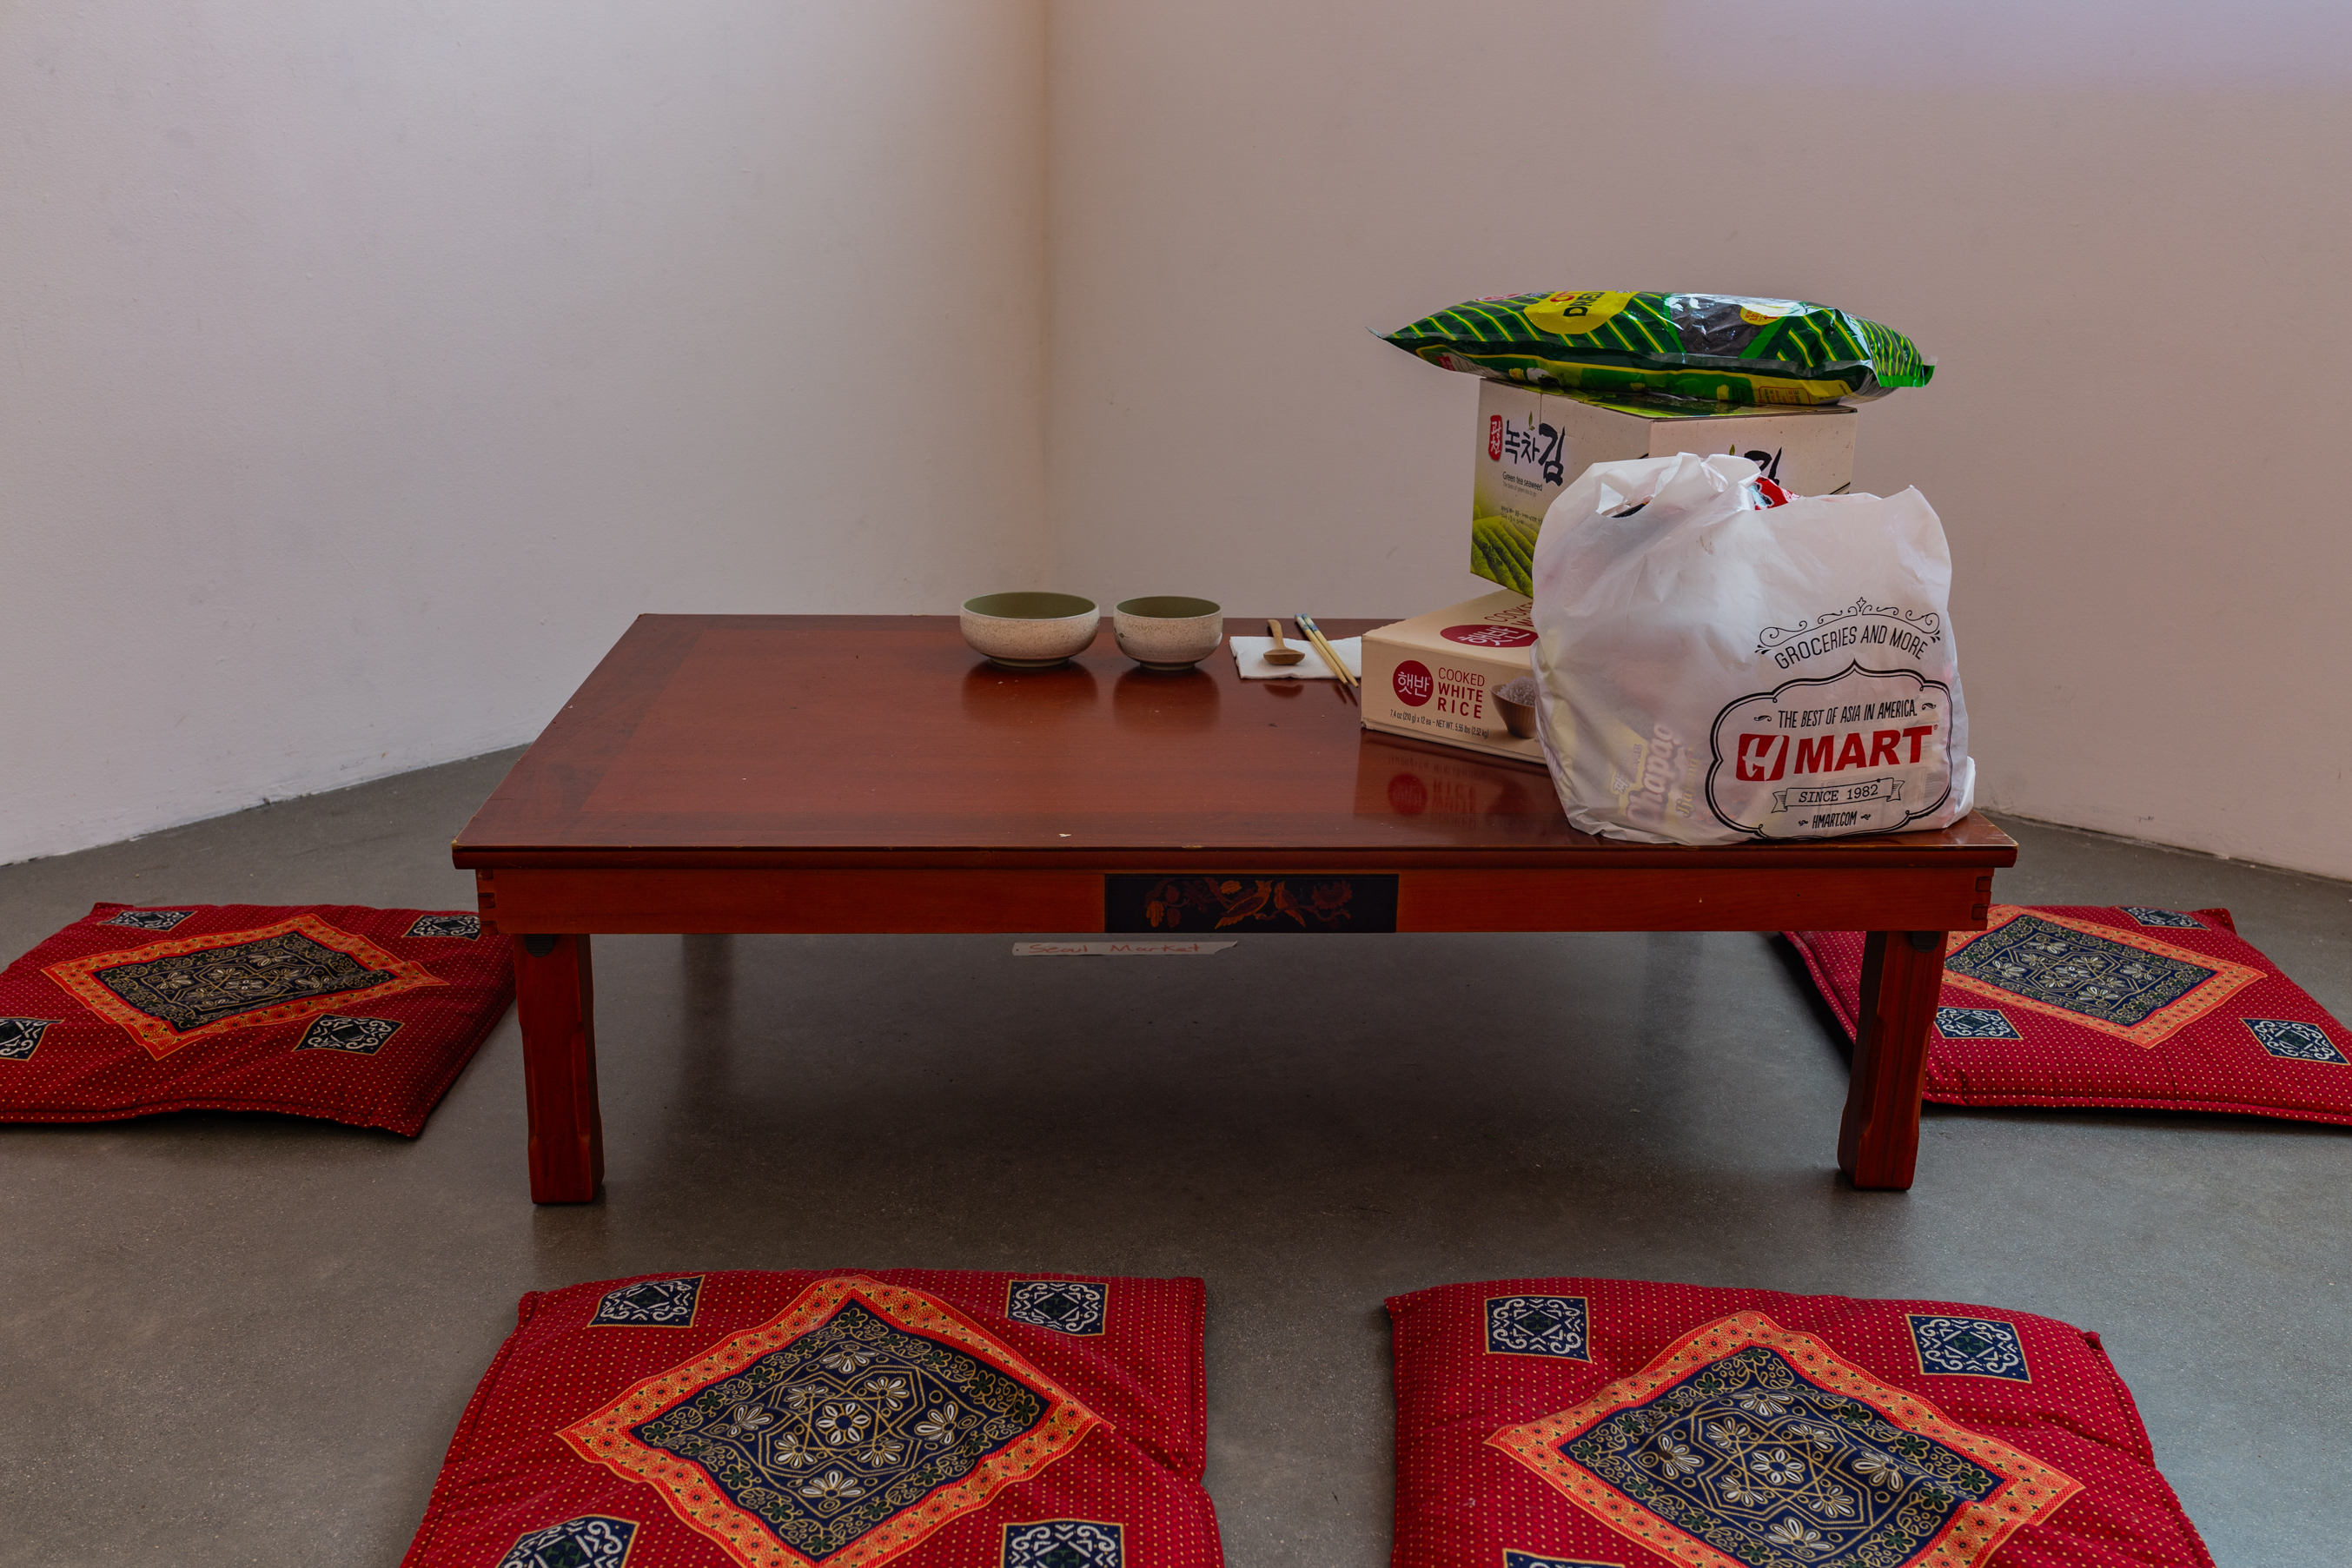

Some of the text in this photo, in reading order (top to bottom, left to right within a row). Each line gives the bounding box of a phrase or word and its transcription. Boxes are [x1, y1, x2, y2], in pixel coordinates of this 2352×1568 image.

[1504, 420, 1566, 486] 녹차김
[1502, 471, 1515, 483] Green
[1524, 478, 1543, 492] seaweed
[1484, 601, 1533, 623] COOK
[1774, 625, 1928, 669] GROCERIES AND MORE
[1397, 671, 1430, 698] 햇반
[1438, 666, 1485, 687] COOKED
[1438, 681, 1484, 703] WHITE
[1437, 697, 1482, 719] RICE
[1779, 699, 1918, 728] THE BEST OF ASIA IN AMERICA.
[1402, 712, 1411, 722] (210
[1411, 715, 1416, 724] g)
[1436, 719, 1445, 728] NET
[1446, 722, 1454, 731] WT.
[1741, 724, 1933, 781] H MART
[1799, 784, 1878, 804] SINCE 1982
[1812, 811, 1858, 829] HMART.COM
[1029, 943, 1088, 954] Seoul
